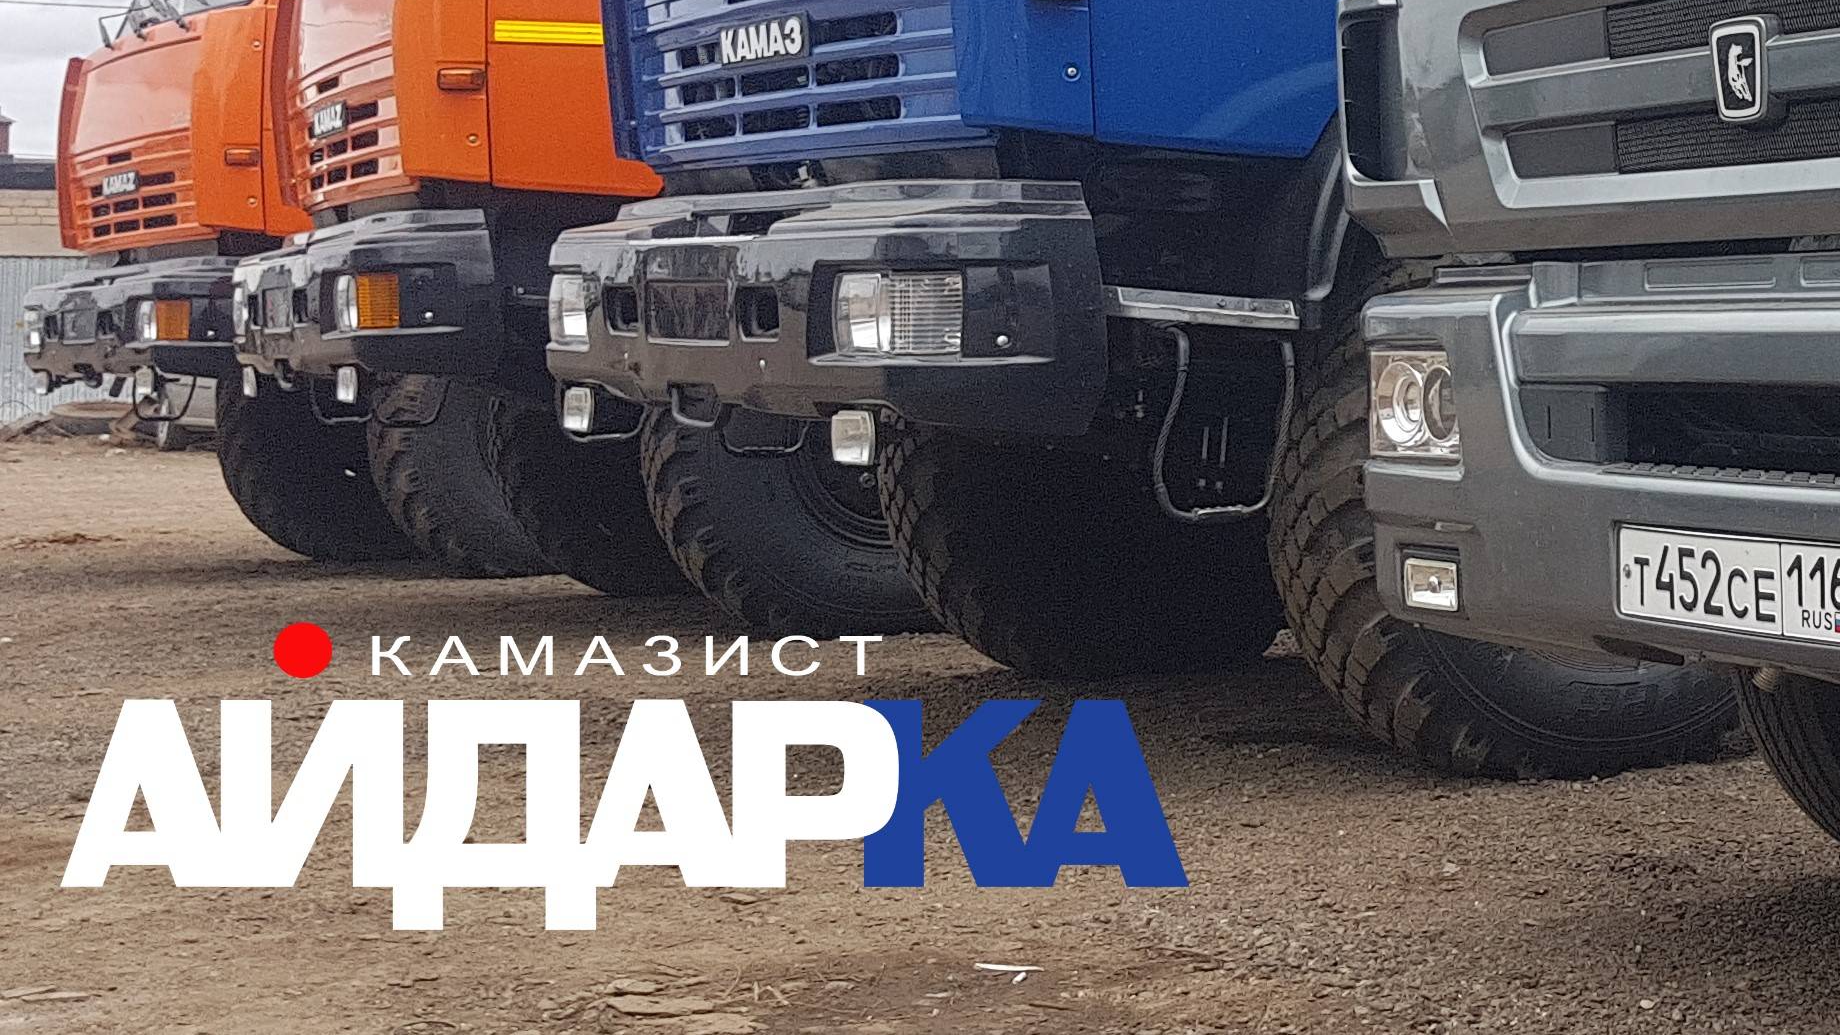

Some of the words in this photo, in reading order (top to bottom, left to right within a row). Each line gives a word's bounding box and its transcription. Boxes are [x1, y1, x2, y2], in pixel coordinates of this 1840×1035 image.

[720, 17, 803, 64] КАМАЗ
[1633, 544, 1777, 624] Т452СЕ
[1801, 609, 1834, 632] RUS
